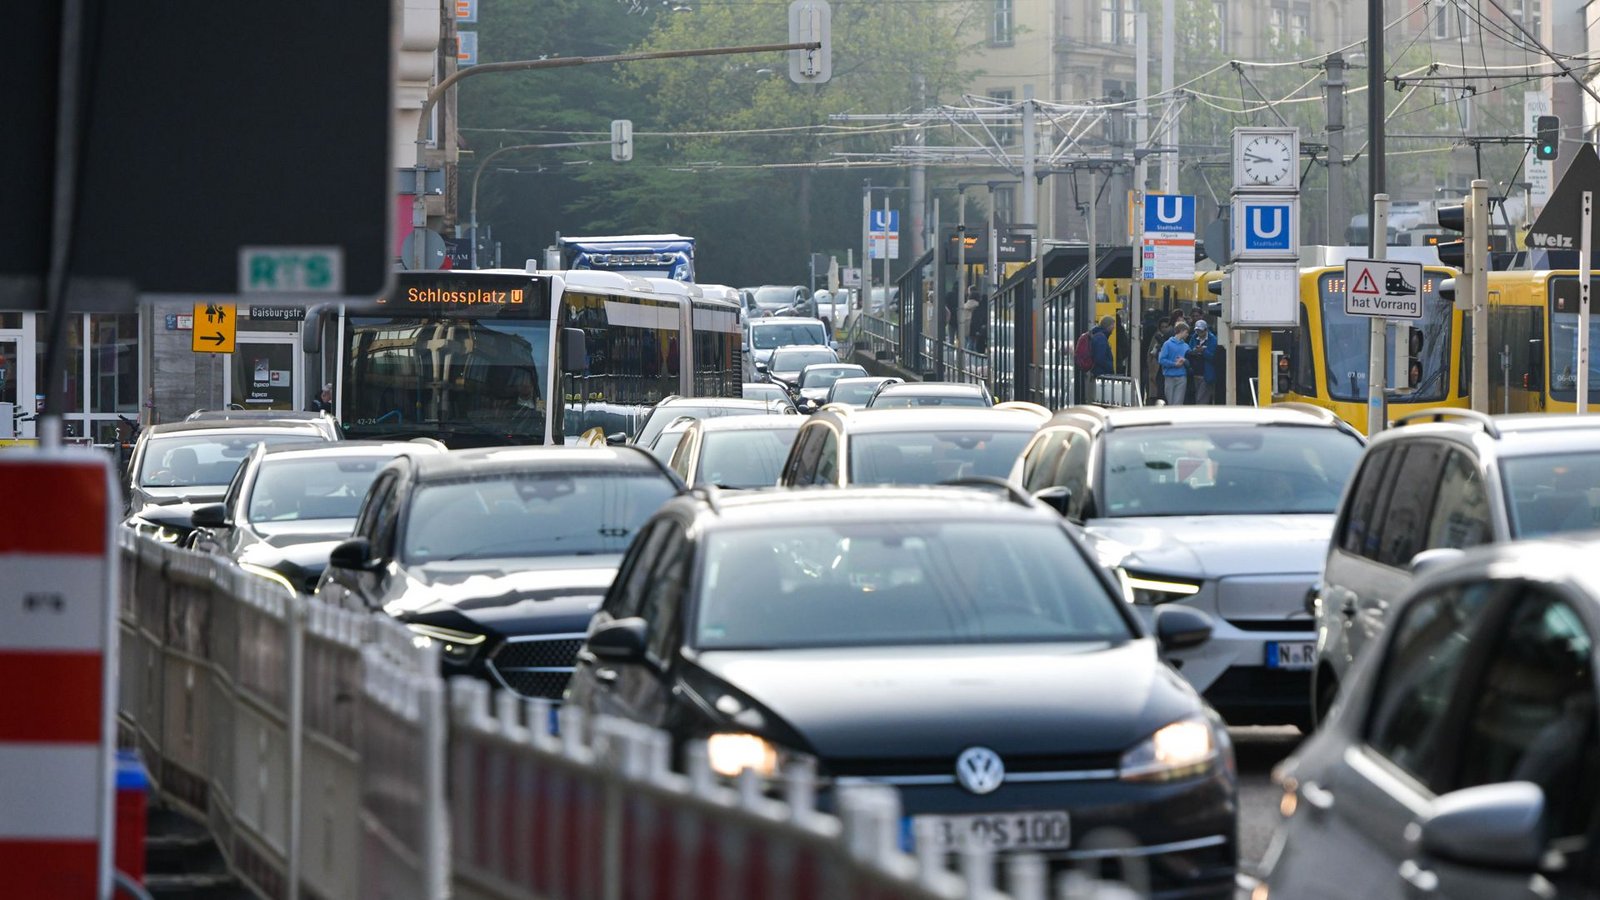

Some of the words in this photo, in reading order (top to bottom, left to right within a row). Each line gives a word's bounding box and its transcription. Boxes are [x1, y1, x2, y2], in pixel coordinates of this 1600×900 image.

[1157, 197, 1182, 223] U
[1253, 208, 1282, 239] U
[1532, 232, 1573, 248] Welz
[249, 253, 333, 289] RTS
[408, 287, 506, 305] Schlossplatz
[1352, 296, 1370, 308] hat
[1374, 297, 1417, 313] Vorrang
[252, 307, 304, 320] Gaisburgstr.
[1016, 815, 1065, 844] 100
